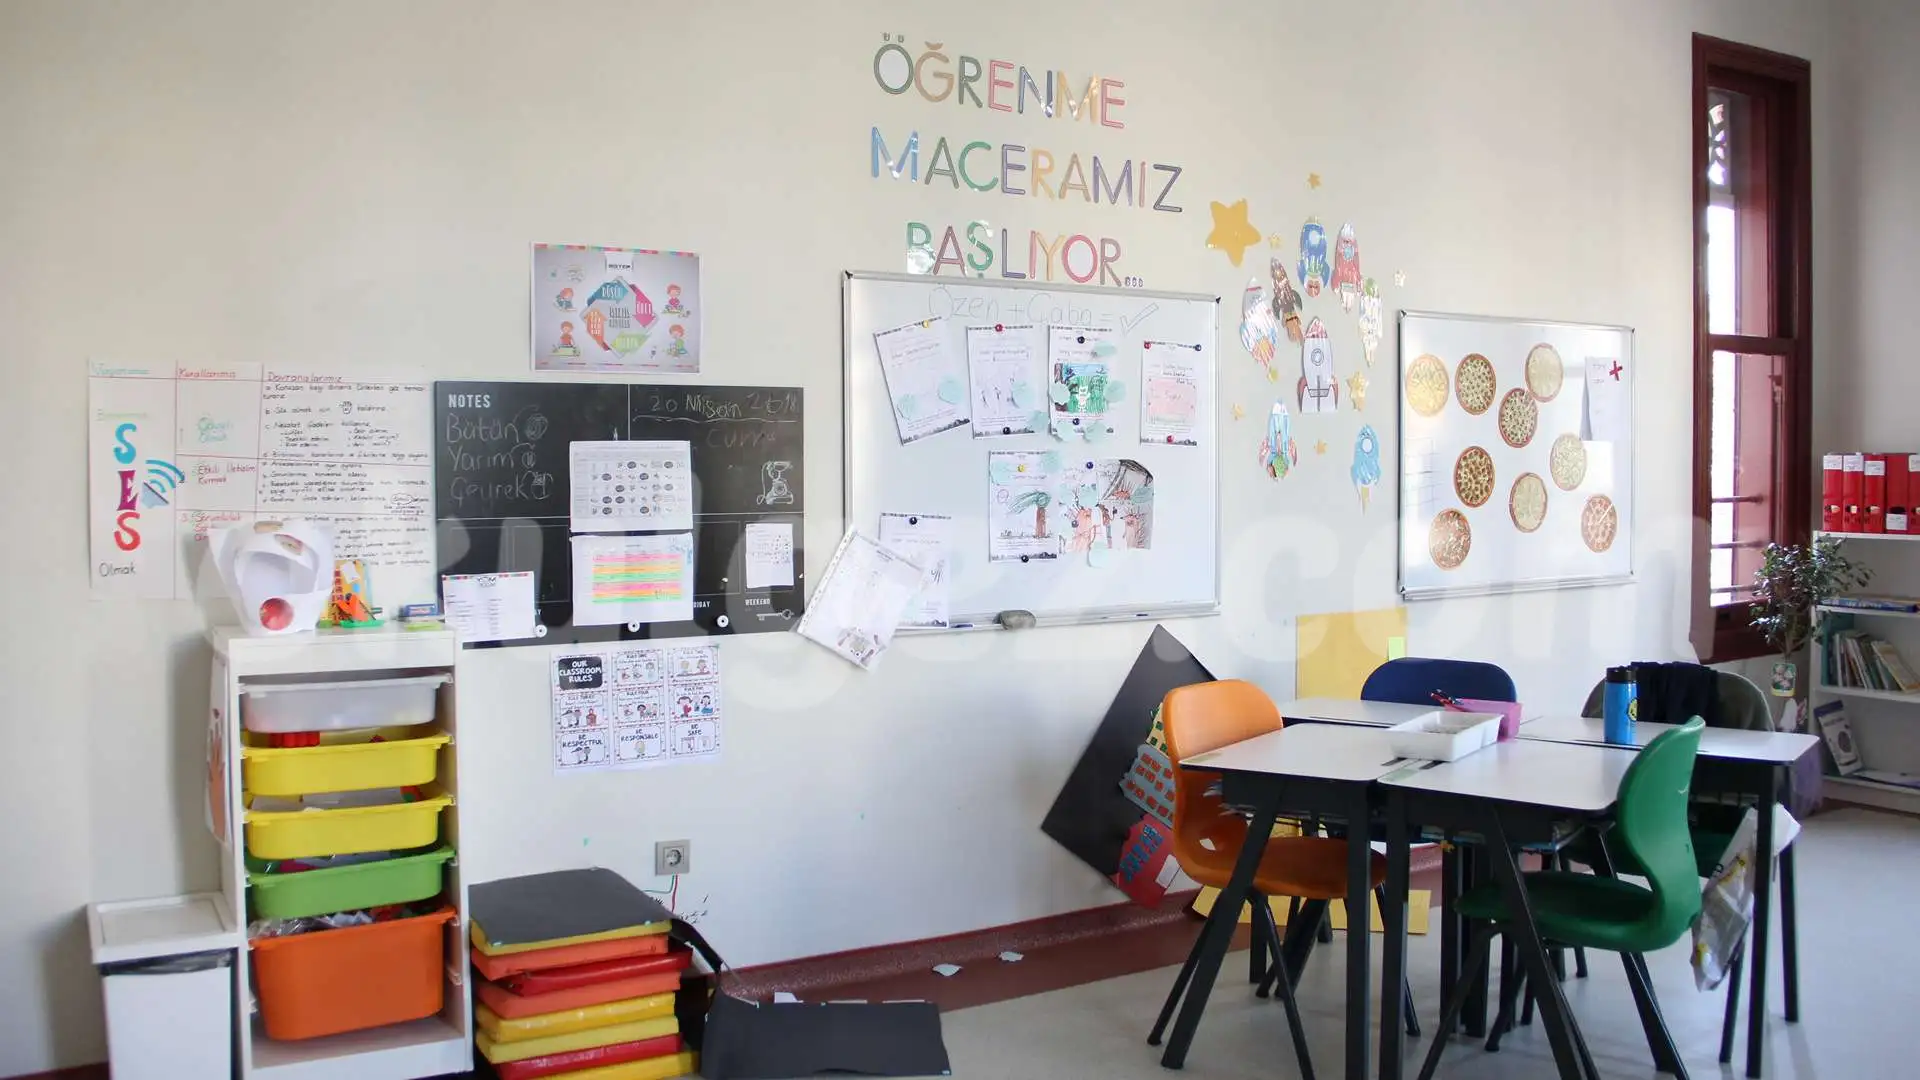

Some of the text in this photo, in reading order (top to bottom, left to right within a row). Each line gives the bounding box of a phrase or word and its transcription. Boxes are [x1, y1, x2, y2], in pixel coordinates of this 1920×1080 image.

[873, 31, 1125, 129] ÖĞRENME
[871, 126, 1183, 213] MACERAMIZ
[448, 394, 491, 408] NOTES
[99, 561, 137, 577] Olmak
[559, 667, 602, 676] CLASSROOM
[569, 675, 593, 683] RULES
